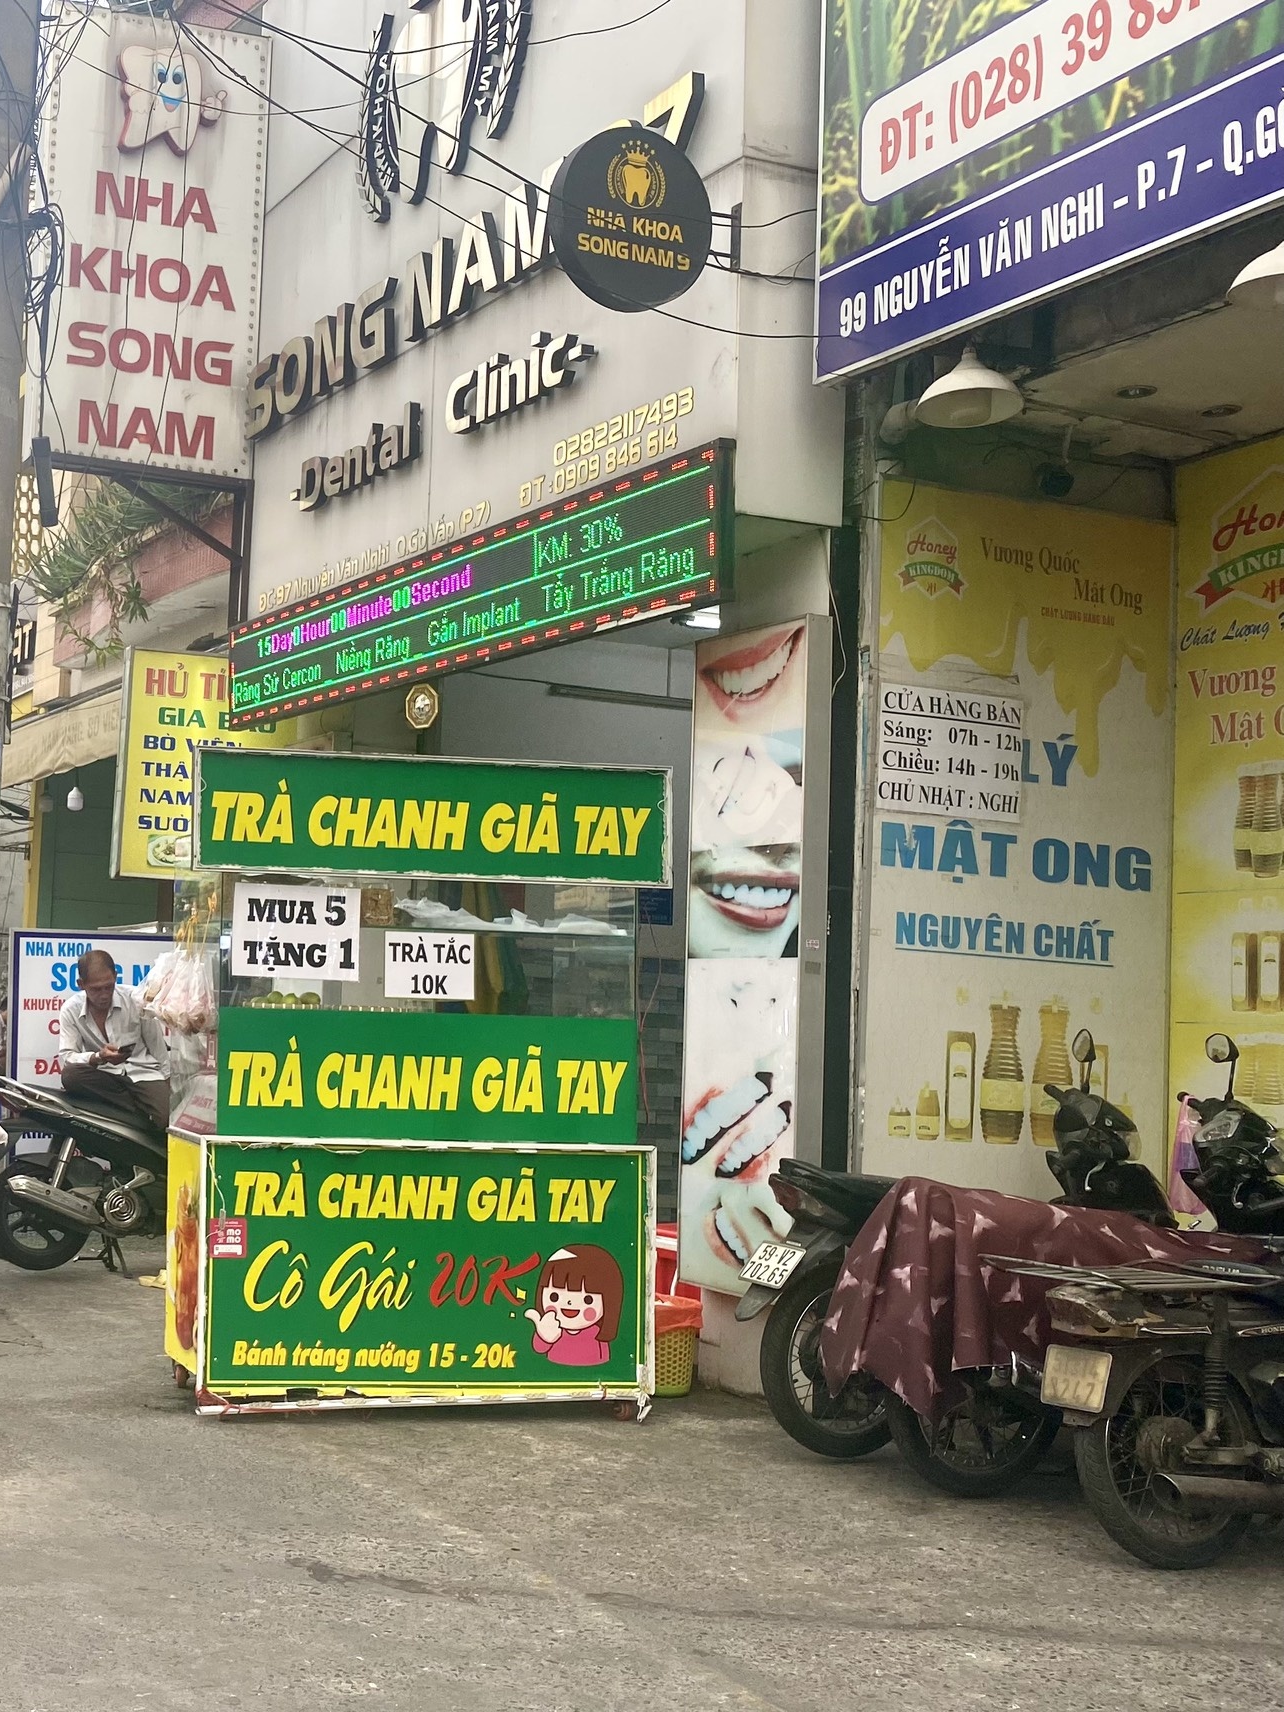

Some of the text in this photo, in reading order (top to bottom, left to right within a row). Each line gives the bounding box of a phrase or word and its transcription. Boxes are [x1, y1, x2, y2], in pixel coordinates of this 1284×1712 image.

[879, 2, 1112, 175] ĐT: (028) 39
[95, 170, 218, 234] NHA
[587, 207, 684, 243] NHA KHOA
[840, 292, 867, 338] 99
[873, 235, 970, 325] NGUYỄN
[979, 217, 1032, 279] VĂN
[1041, 182, 1104, 253] NGHI
[1136, 145, 1187, 210] P.7
[577, 233, 691, 271] SONG NAM 9
[69, 242, 236, 312] KHOA
[66, 321, 235, 387] SONG
[244, 277, 398, 441] SONG
[77, 398, 215, 461] NAM
[553, 386, 694, 467] 02822117493
[646, 423, 678, 455] 614
[458, 500, 492, 534] (P.7)
[579, 512, 624, 553] 30%
[906, 533, 958, 565] Honey
[1038, 547, 1080, 575] Quốc
[908, 564, 957, 583] KINGDOM
[1073, 577, 1143, 615] Mật Ong
[282, 662, 322, 690] Cercon
[462, 597, 522, 639] Implant
[145, 662, 189, 698] HỦ
[1188, 666, 1276, 698] Vương
[158, 707, 206, 729] GIA
[884, 688, 1021, 724] CỬA HÀNG BÁN
[143, 733, 176, 751] BÒ
[884, 720, 1021, 752] Sáng: 07h 12h
[1210, 711, 1265, 748] Mật
[141, 761, 189, 783] THẬ
[882, 748, 1019, 781] Chiều: 14h 19h
[140, 788, 194, 805] NAM
[879, 779, 914, 802] CHỦ
[919, 785, 965, 811] NHẬT
[138, 814, 191, 832] SƯỜ
[211, 778, 652, 857] TRÀ CHANH GIÃ TAY
[880, 819, 1152, 892] MẬT ONG
[248, 895, 347, 926] MUA 5
[25, 941, 54, 957] NHA
[244, 936, 355, 972] TẶNG 1
[389, 937, 472, 964] TRÀ TẮC
[895, 912, 1114, 962] NGUYÊN CHẤT
[411, 974, 448, 995] 10K
[228, 1036, 628, 1115] TRÀ CHANH GIÃ TAY
[233, 1160, 617, 1223] TRÀ CHANH GIÃ TAY
[242, 1239, 542, 1333] Cô Gái 20K
[742, 1261, 788, 1284] 702.65
[232, 1340, 517, 1374] Bánh tráng nướng 15 20k
